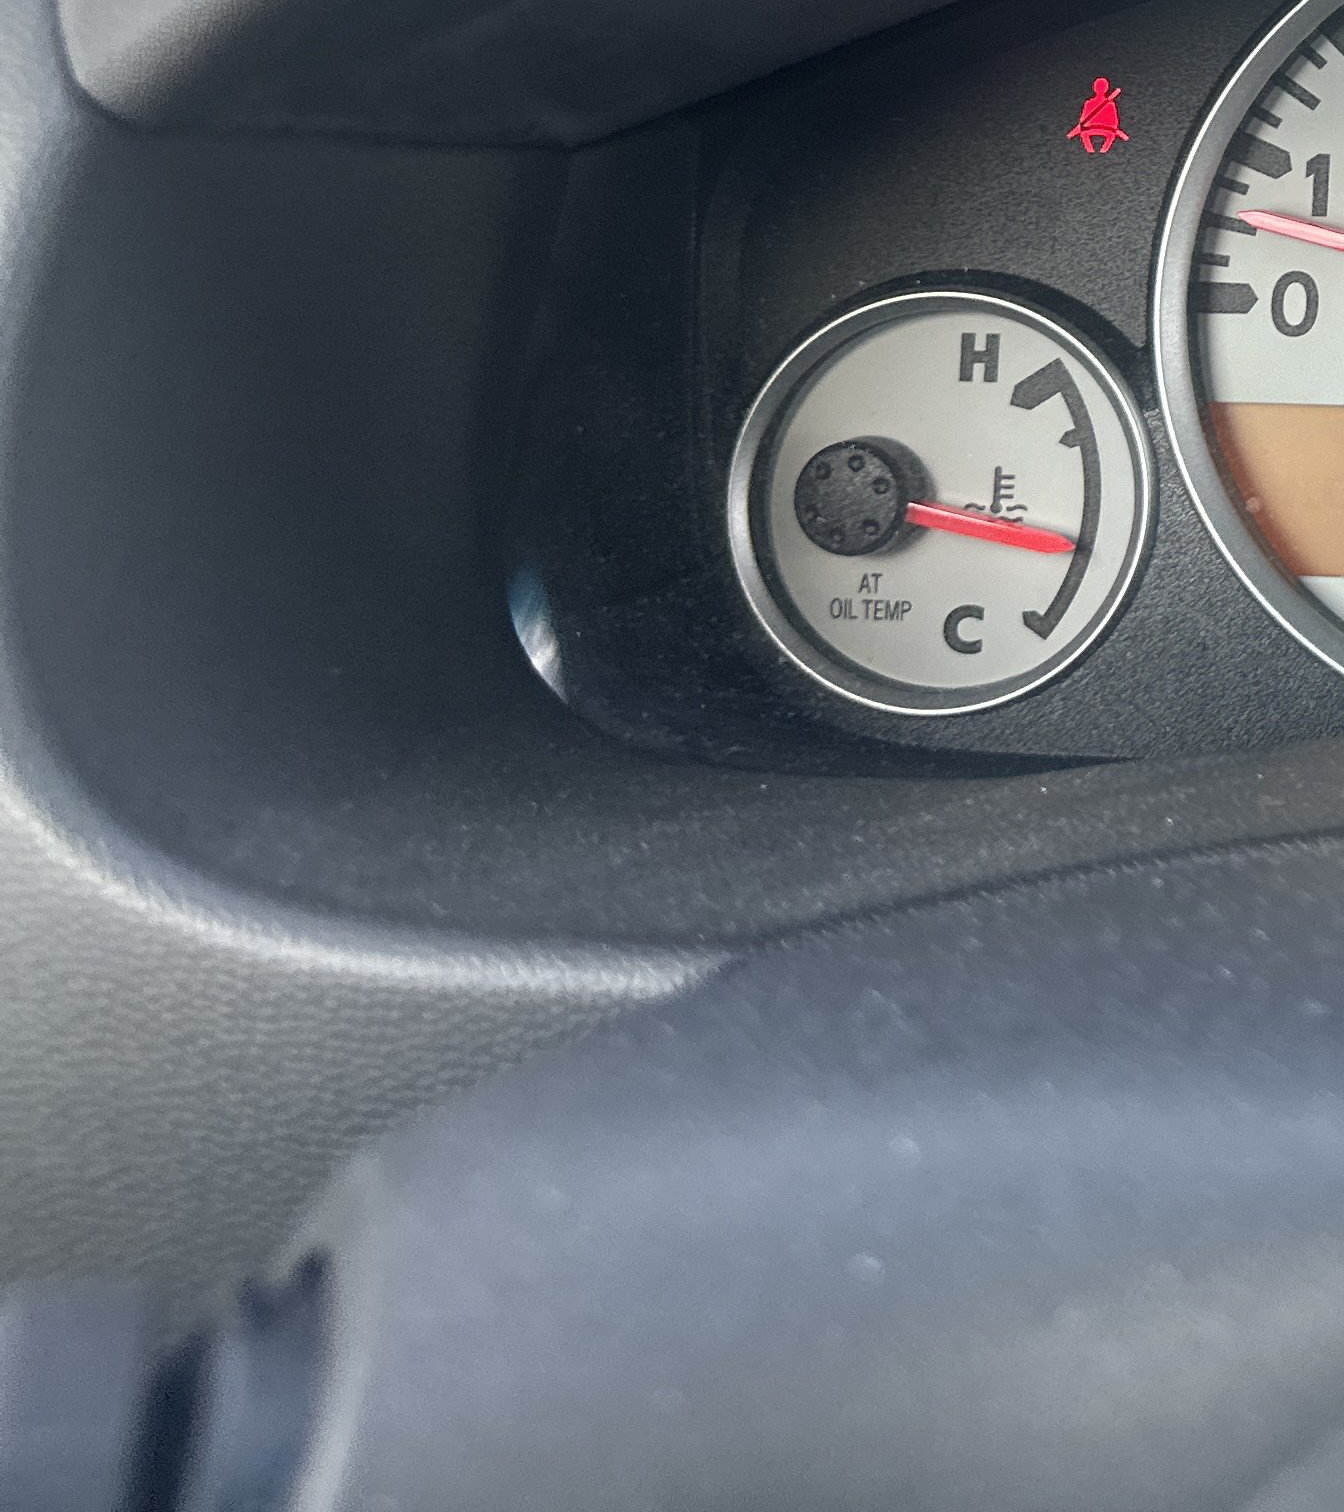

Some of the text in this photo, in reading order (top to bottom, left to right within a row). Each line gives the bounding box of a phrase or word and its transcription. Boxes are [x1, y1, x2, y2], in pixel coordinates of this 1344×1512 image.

[1305, 154, 1331, 216] 1
[1271, 272, 1319, 336] 0
[959, 333, 1000, 382] H
[859, 573, 883, 593] AT
[830, 600, 912, 620] OIL TEMP
[943, 605, 984, 654] C
